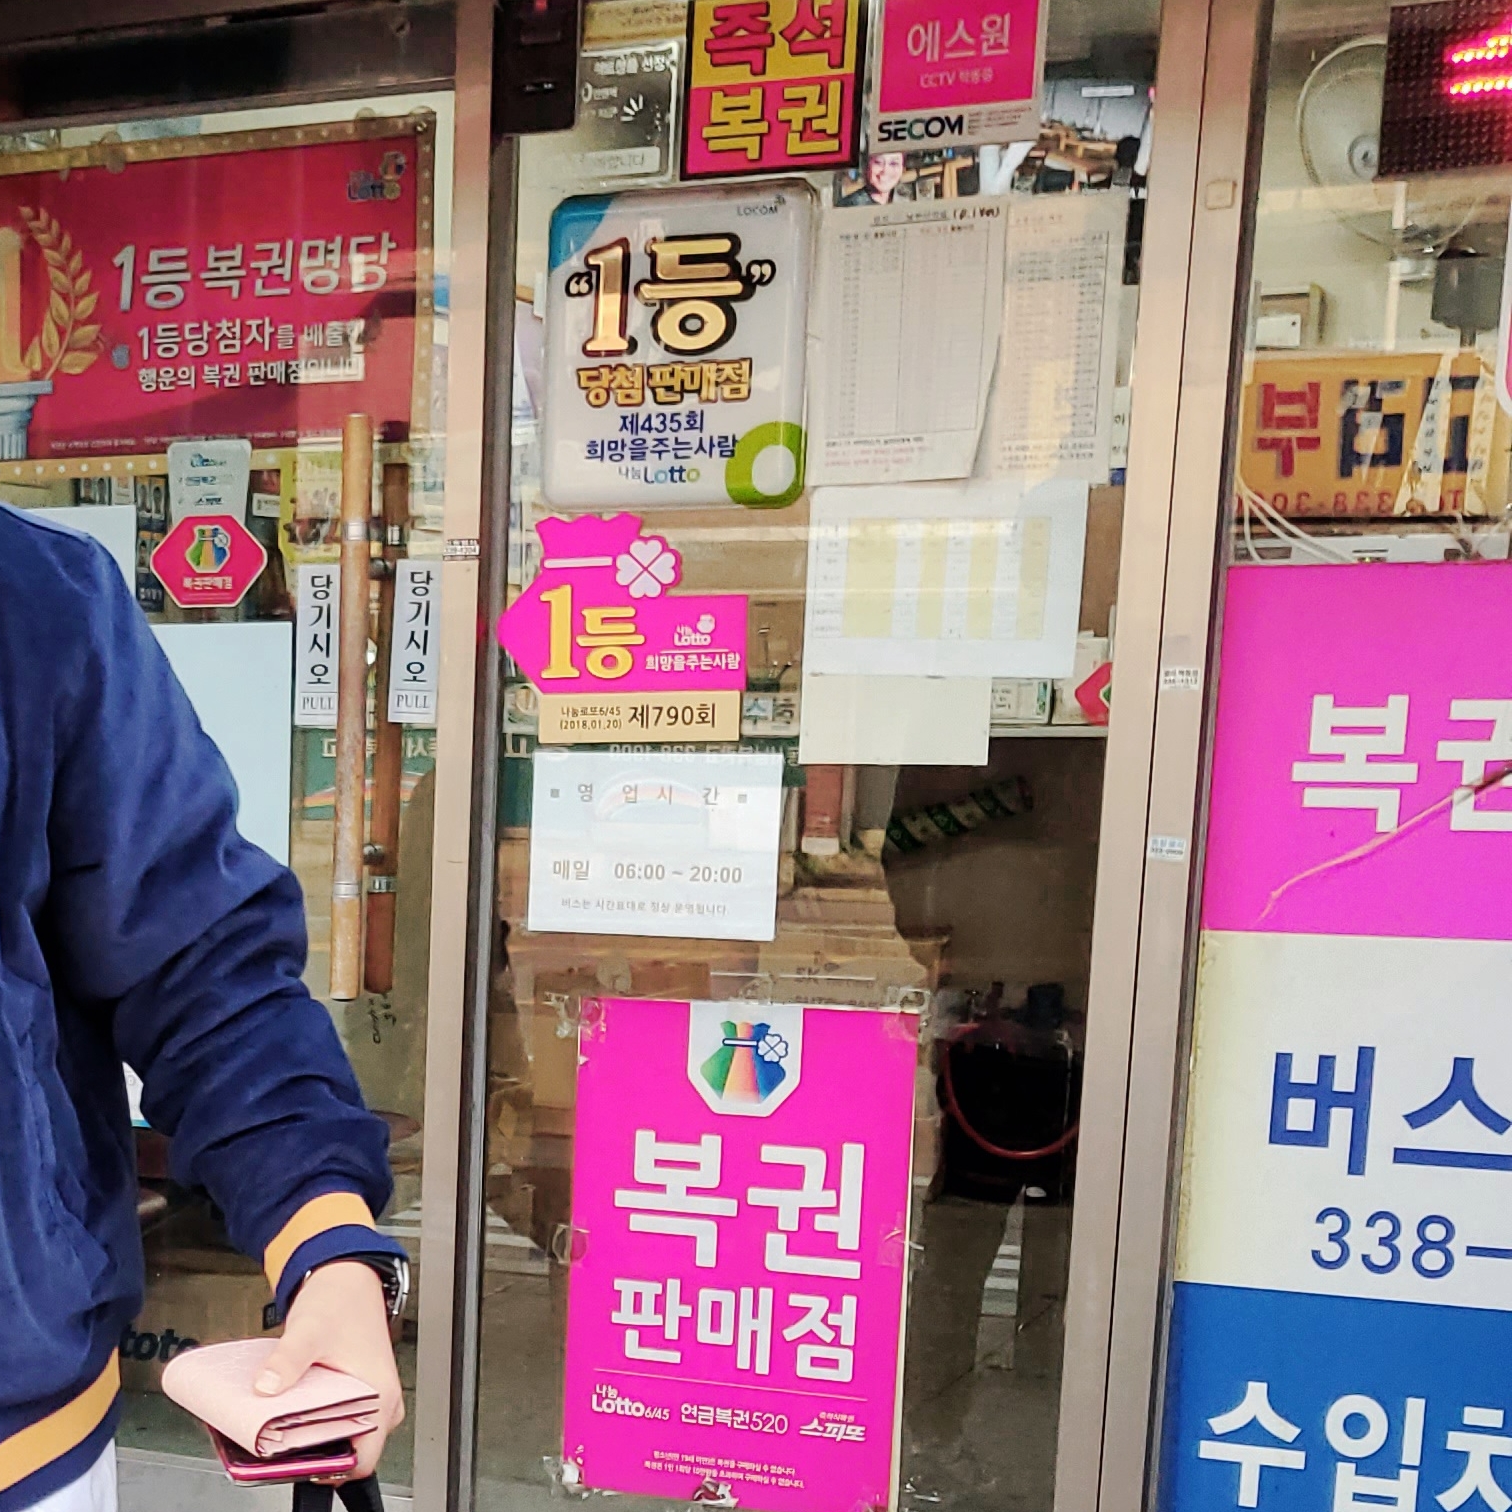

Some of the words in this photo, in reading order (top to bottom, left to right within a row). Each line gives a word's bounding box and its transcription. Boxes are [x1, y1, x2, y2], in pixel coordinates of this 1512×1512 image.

[704, 0, 849, 76] 즉석
[907, 12, 1010, 63] 에스원
[702, 80, 841, 160] 복권
[878, 114, 964, 142] SECOM
[112, 244, 192, 312] 1등
[199, 230, 397, 300] 복권명당
[138, 365, 196, 393] 행운의
[202, 360, 241, 388] 복권
[578, 363, 645, 407] 당첨
[647, 358, 753, 405] 판매점
[618, 410, 705, 436] 제435회
[643, 465, 701, 484] Lotto
[307, 574, 333, 685] 당기시오
[402, 570, 434, 683] 당기시오
[540, 584, 645, 679] 1등
[674, 632, 711, 646] Lotto
[302, 696, 335, 711] PULL
[397, 694, 431, 709] PULL
[628, 703, 715, 728] 제790회
[553, 860, 590, 881] 매일
[614, 863, 665, 880] 06:00
[689, 866, 743, 884] 20:00
[1268, 1046, 1512, 1176] 버스
[614, 1129, 865, 1279] 복권
[1311, 1207, 1512, 1279] 338-
[611, 1278, 858, 1383] 판매점
[595, 1384, 618, 1398] 나눔
[680, 1403, 789, 1434] 연금복권520
[798, 1418, 867, 1442] 스피또
